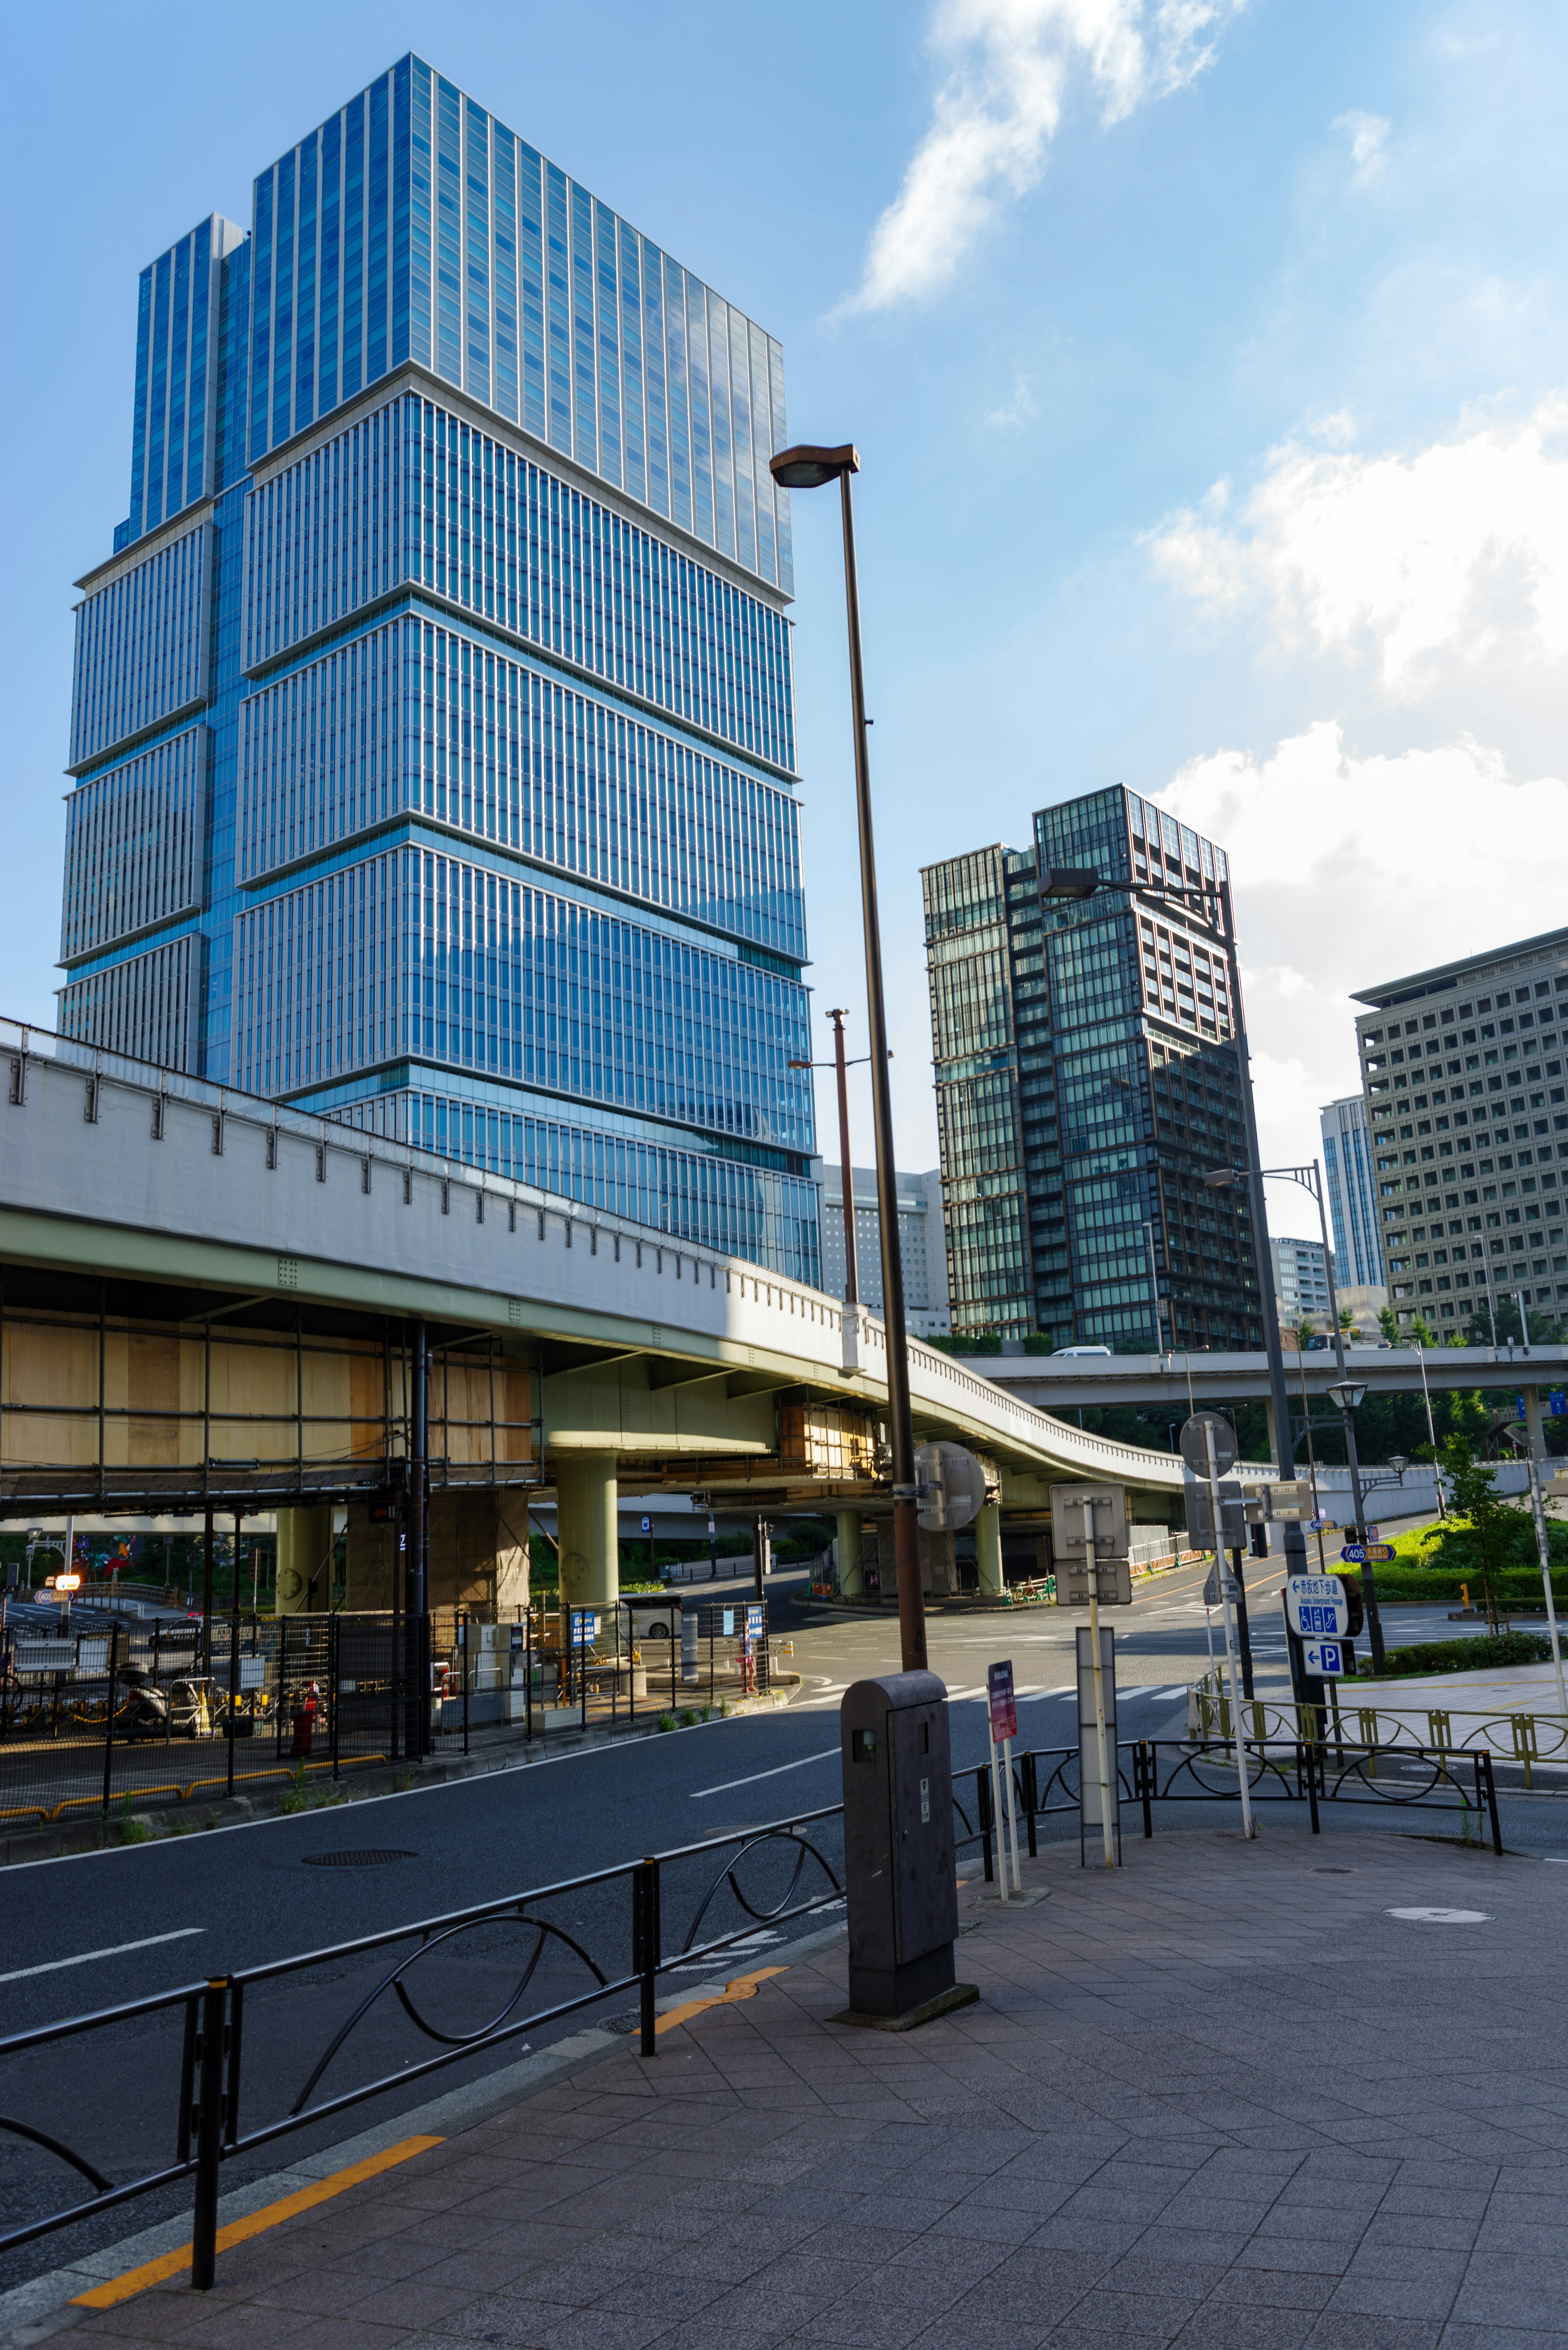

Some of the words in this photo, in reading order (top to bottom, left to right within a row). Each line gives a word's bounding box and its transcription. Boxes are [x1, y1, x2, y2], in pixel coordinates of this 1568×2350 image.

[1349, 1549, 1364, 1558] 405
[1301, 1579, 1338, 1594] 赤坂地下歩道
[1312, 1597, 1330, 1606] Underground
[1331, 1597, 1343, 1607] Passage
[1325, 1648, 1336, 1668] P
